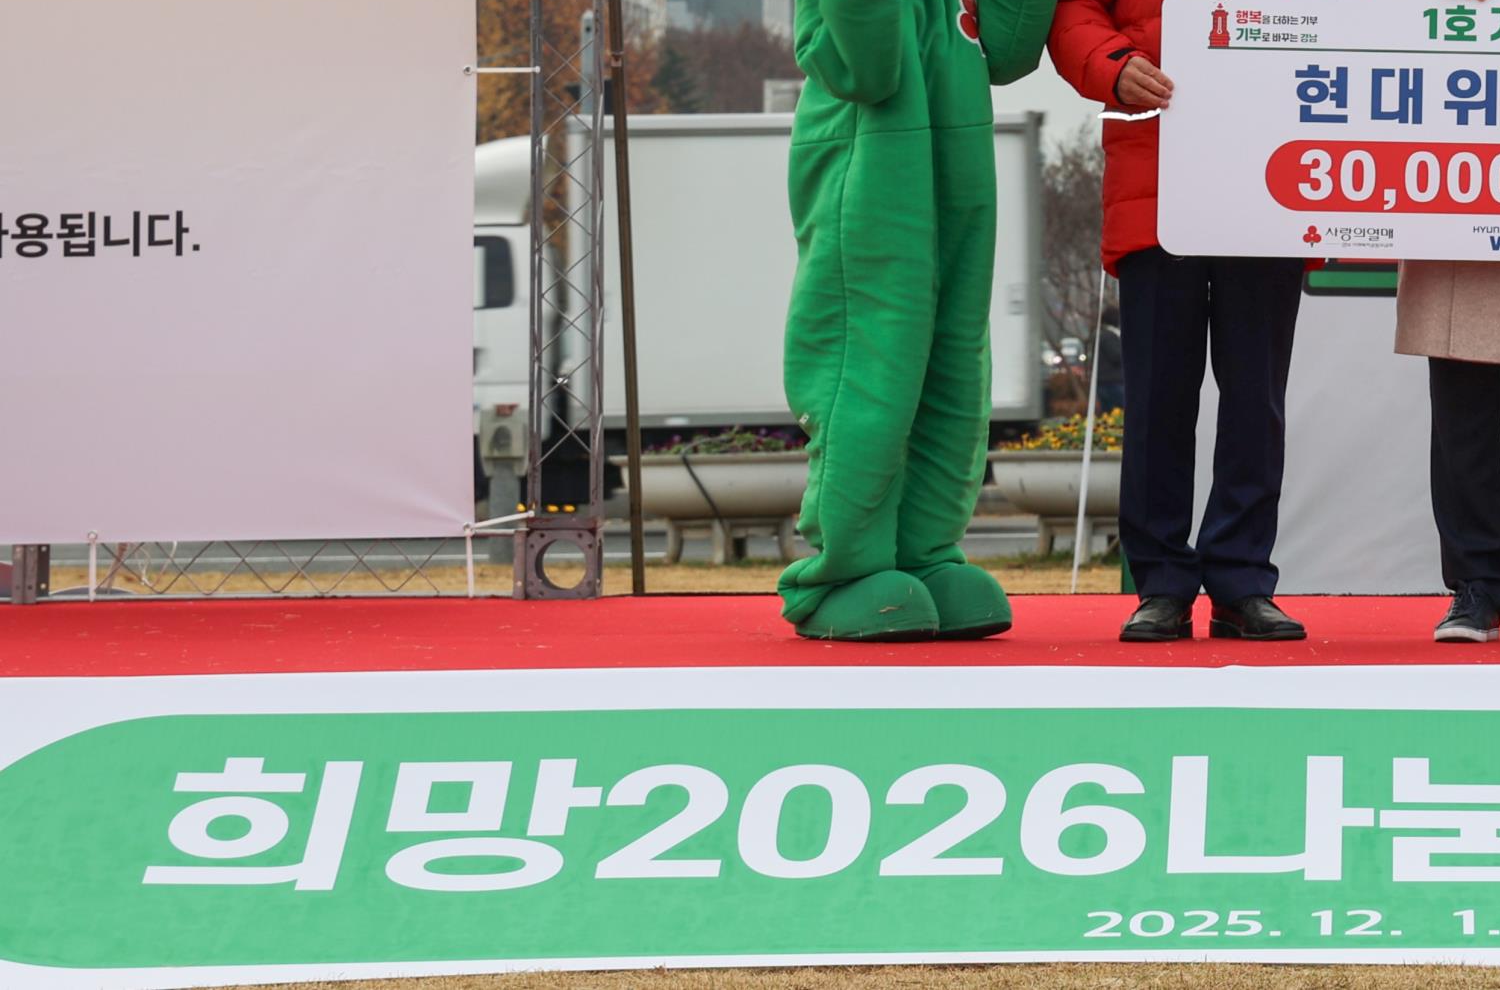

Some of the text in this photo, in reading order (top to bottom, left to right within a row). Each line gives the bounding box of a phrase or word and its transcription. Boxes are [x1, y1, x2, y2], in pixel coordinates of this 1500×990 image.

[1236, 10, 1319, 26] 행복을 더하는 기부
[1423, 5, 1478, 42] 1호
[1236, 28, 1319, 44] 기부로 바꾸는 경남
[1084, 909, 1281, 938] 2025.
[1311, 909, 1402, 936] 12.
[1454, 909, 1500, 936] 1.
